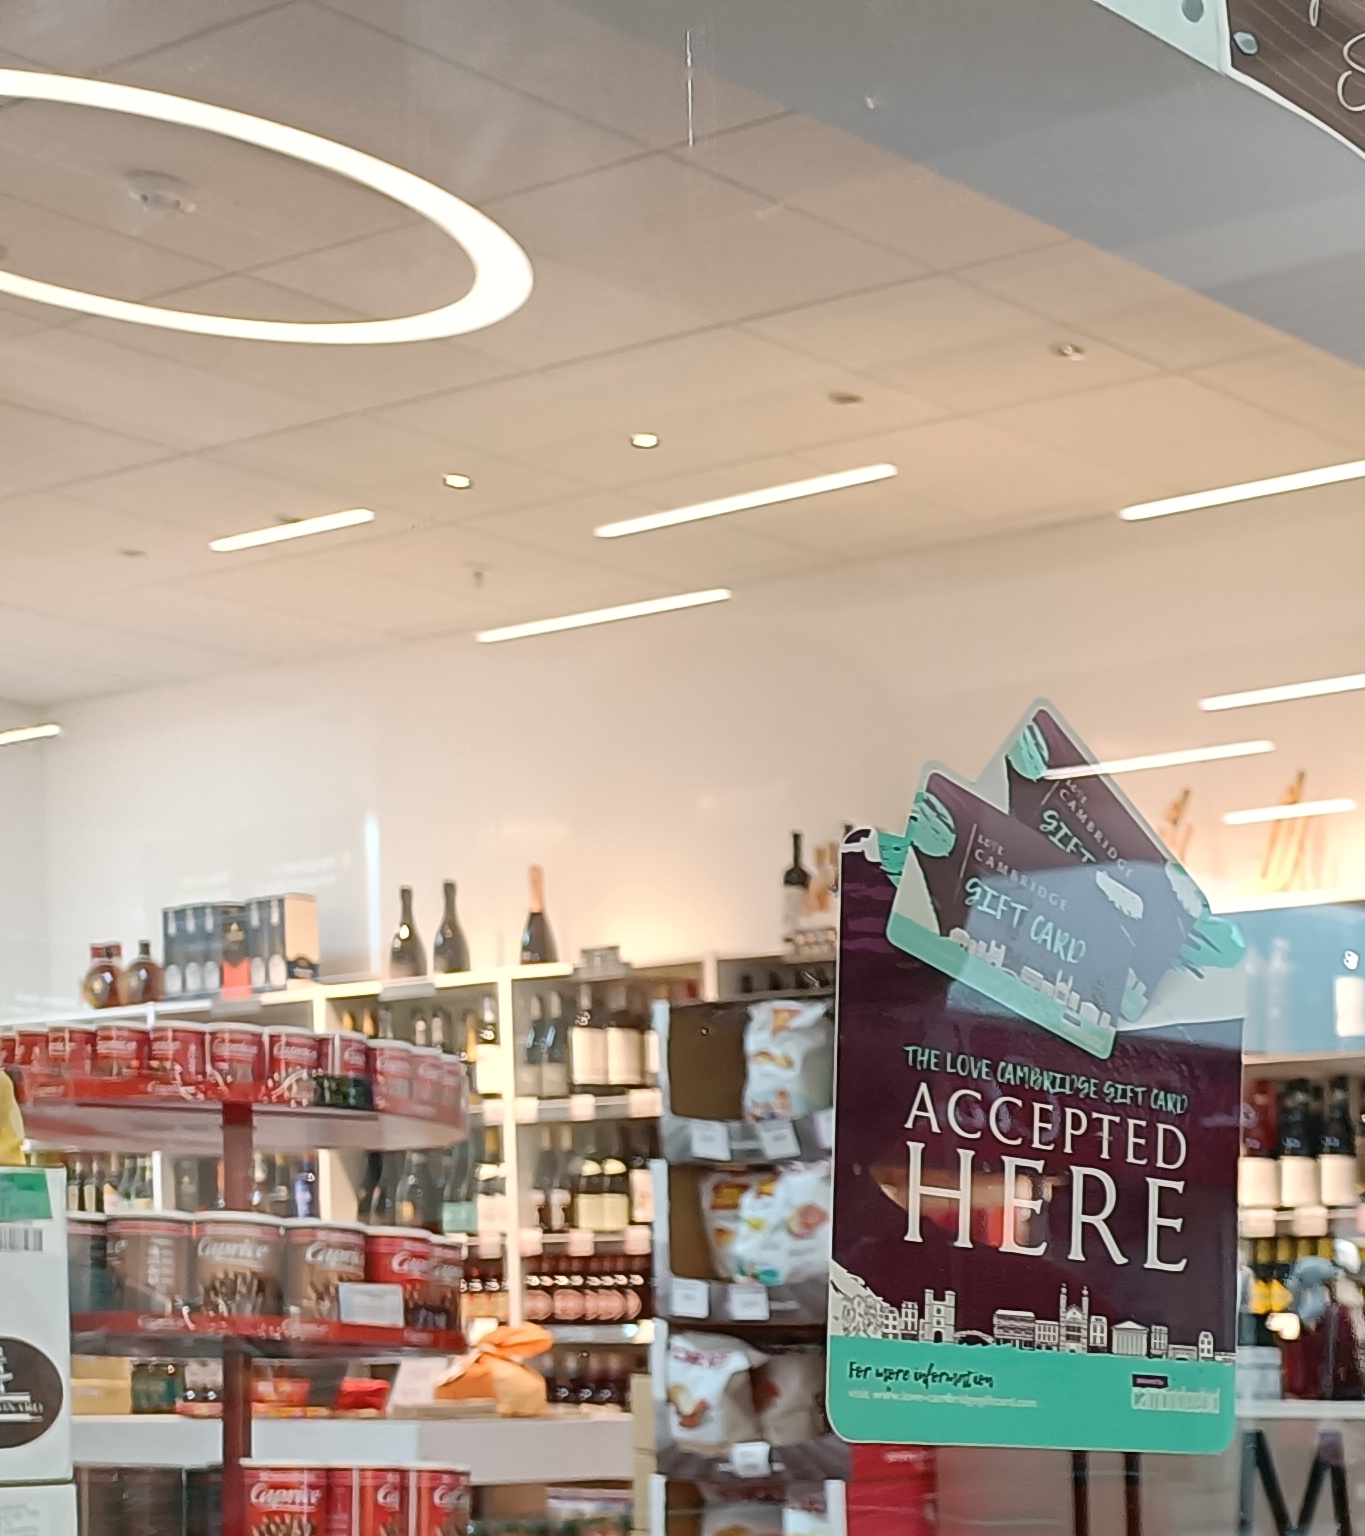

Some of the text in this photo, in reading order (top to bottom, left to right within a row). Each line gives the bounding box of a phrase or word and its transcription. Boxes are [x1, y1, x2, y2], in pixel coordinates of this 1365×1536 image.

[1040, 810, 1097, 864] GIFT
[974, 849, 1068, 911] CAMBRIDGE
[964, 877, 1087, 963] GIFT CARD
[903, 1045, 1189, 1115] THE LOVE CAMBRIDGE GIFT CARD
[903, 1082, 1187, 1170] ACCEPTED
[903, 1140, 1188, 1272] HERE
